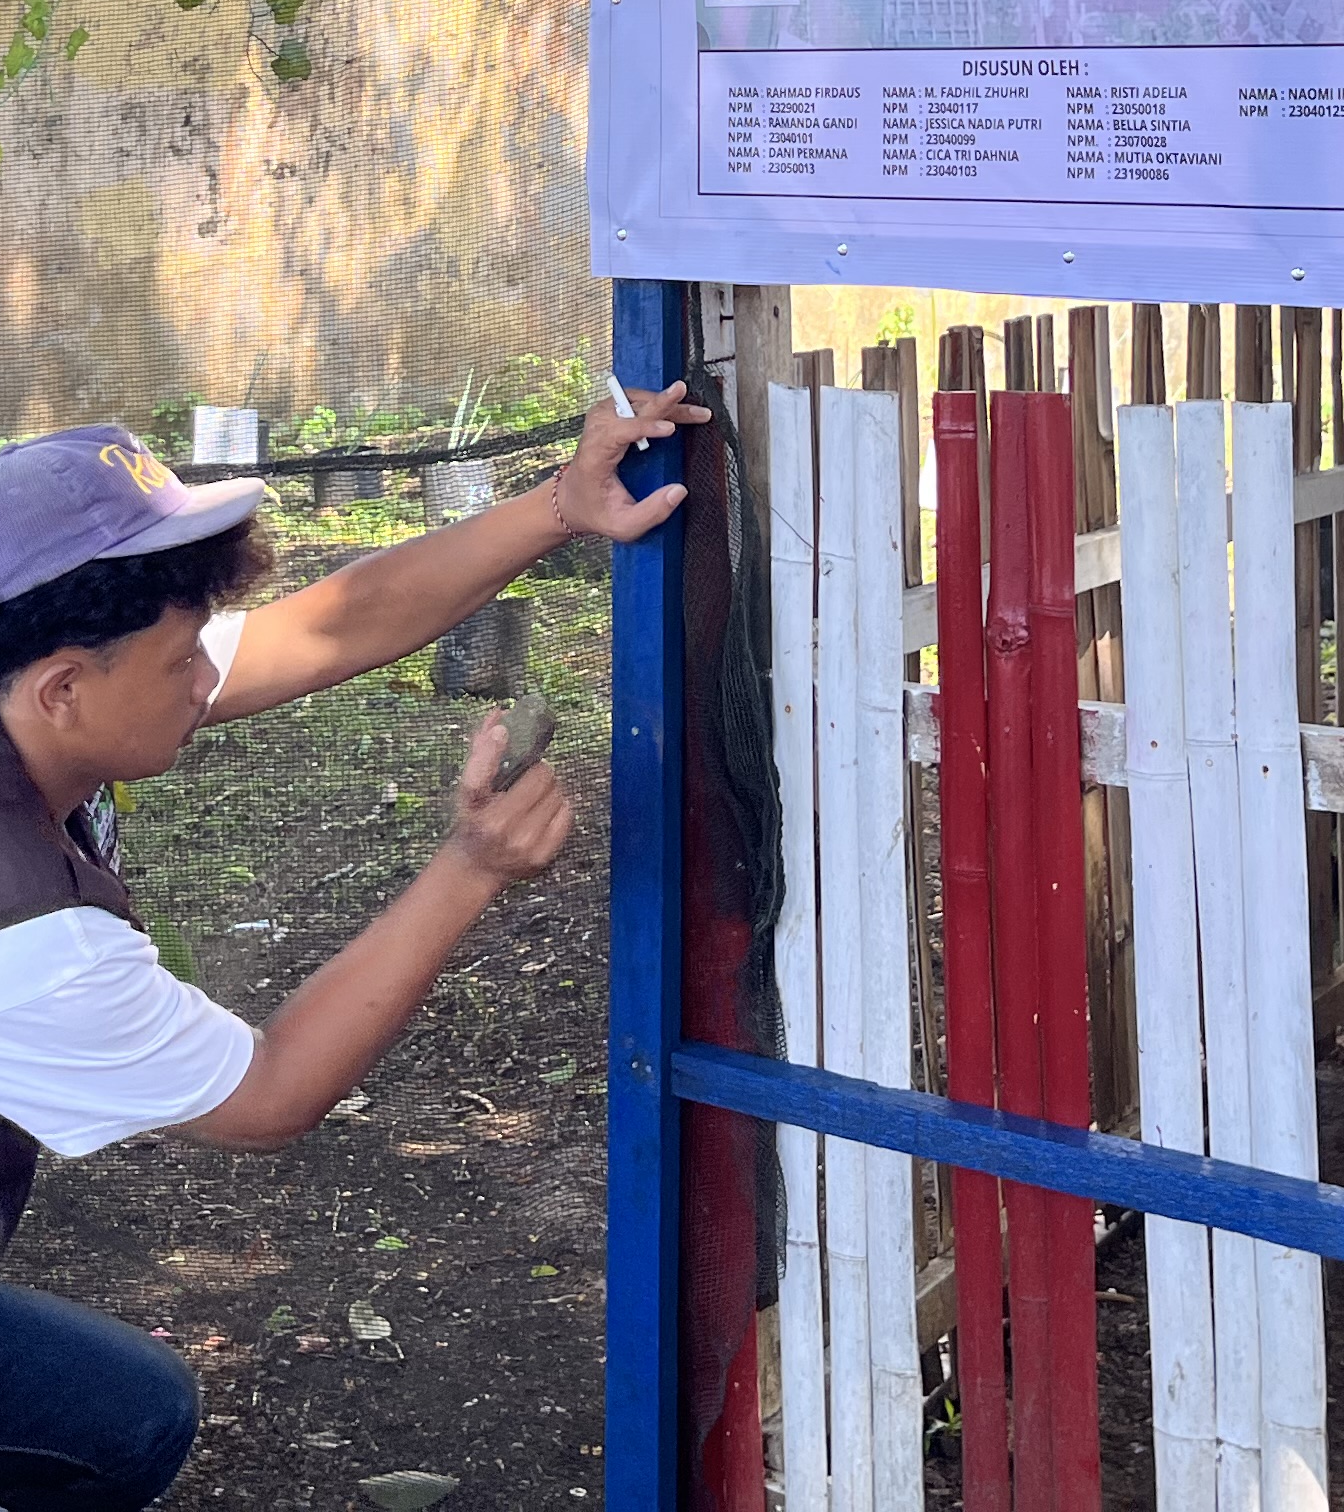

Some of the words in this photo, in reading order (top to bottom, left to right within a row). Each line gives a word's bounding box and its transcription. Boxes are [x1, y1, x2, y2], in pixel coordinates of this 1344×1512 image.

[963, 60, 1033, 76] DISUSUN
[1038, 60, 1079, 76] OLEH
[729, 87, 759, 98] NAMA
[766, 87, 812, 98] RAHMAD
[815, 87, 861, 98] FIRDAUS
[883, 87, 916, 98] NAMA
[941, 87, 982, 98] FADHIL
[985, 87, 1028, 98] ZHUHRI
[1066, 87, 1102, 98] NAMA
[1111, 87, 1139, 98] RISTI
[1143, 87, 1187, 99] ADELIA
[1239, 88, 1278, 100] NAMA
[1288, 88, 1333, 100] NAOMI
[729, 102, 752, 113] NPM
[770, 102, 815, 114] 23290021
[883, 102, 908, 113] NPM
[928, 102, 978, 114] 23040117
[1067, 103, 1094, 114] NPM
[1111, 103, 1165, 115] 23050018
[1240, 105, 1268, 117] NPM
[728, 117, 761, 128] NAMA
[768, 117, 820, 129] RAMANDA
[823, 118, 857, 129] GANDI
[883, 118, 917, 129] NAMA
[924, 118, 965, 132] JESSICA
[968, 118, 1005, 130] NADIA
[1008, 118, 1042, 130] PUTRI
[1068, 119, 1104, 130] NAMA
[1113, 119, 1148, 131] BELLA
[1150, 120, 1191, 131] SINTIA
[728, 132, 752, 143] NPM
[769, 132, 812, 144] 23040101
[883, 133, 908, 144] NPM
[926, 133, 976, 145] 23040099
[1114, 135, 1167, 148] 23070028
[728, 147, 760, 158] NAMA
[769, 147, 794, 158] DANI
[797, 148, 848, 159] PERMANA
[883, 149, 917, 160] NAMA
[926, 149, 952, 161] CICA
[954, 149, 971, 161] TRI
[974, 150, 1019, 162] DAHNIA
[1067, 151, 1104, 163] NAMA
[1114, 151, 1153, 164] MUTIA
[1156, 152, 1222, 165] OKTAVIANI
[728, 161, 751, 173] NPM
[768, 162, 815, 175] 23050013
[883, 164, 908, 175] NPM
[926, 165, 977, 177] 23040103
[1067, 167, 1094, 179] NPM
[1114, 168, 1169, 181] 23190086
